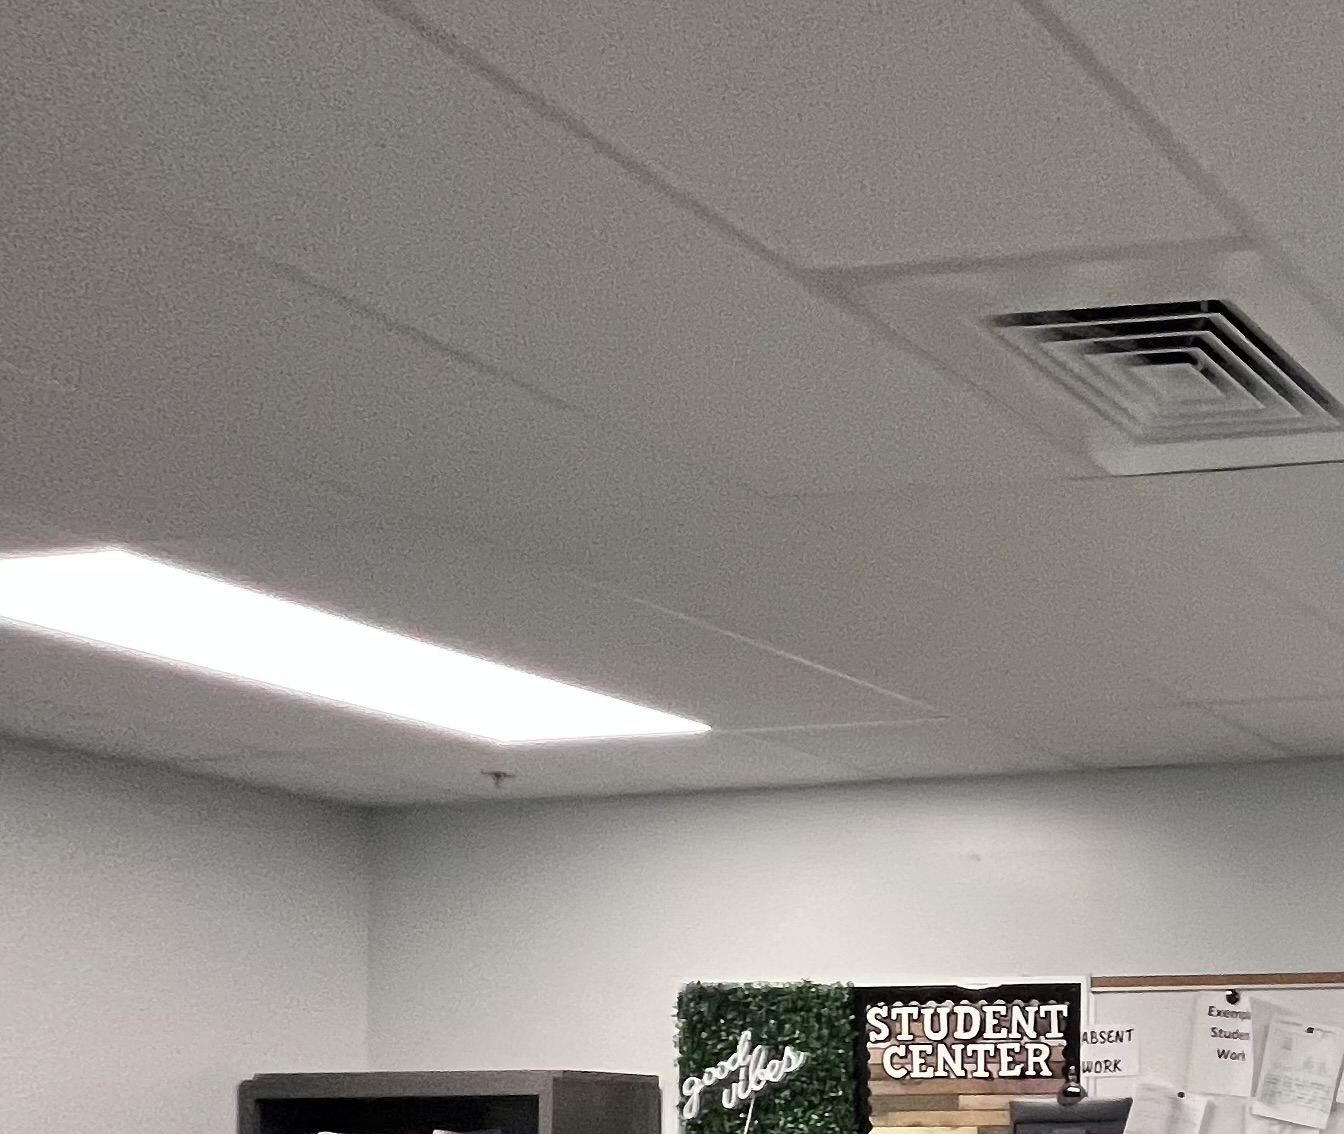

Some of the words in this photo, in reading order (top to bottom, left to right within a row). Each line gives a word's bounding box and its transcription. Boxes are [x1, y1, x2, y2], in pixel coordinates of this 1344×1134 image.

[866, 1004, 1069, 1042] STUDENT
[1082, 1028, 1135, 1045] ABSENT
[682, 1029, 752, 1120] good
[721, 1044, 812, 1109] vibes
[882, 1042, 1053, 1079] CENTER
[1082, 1059, 1123, 1074] WORK
